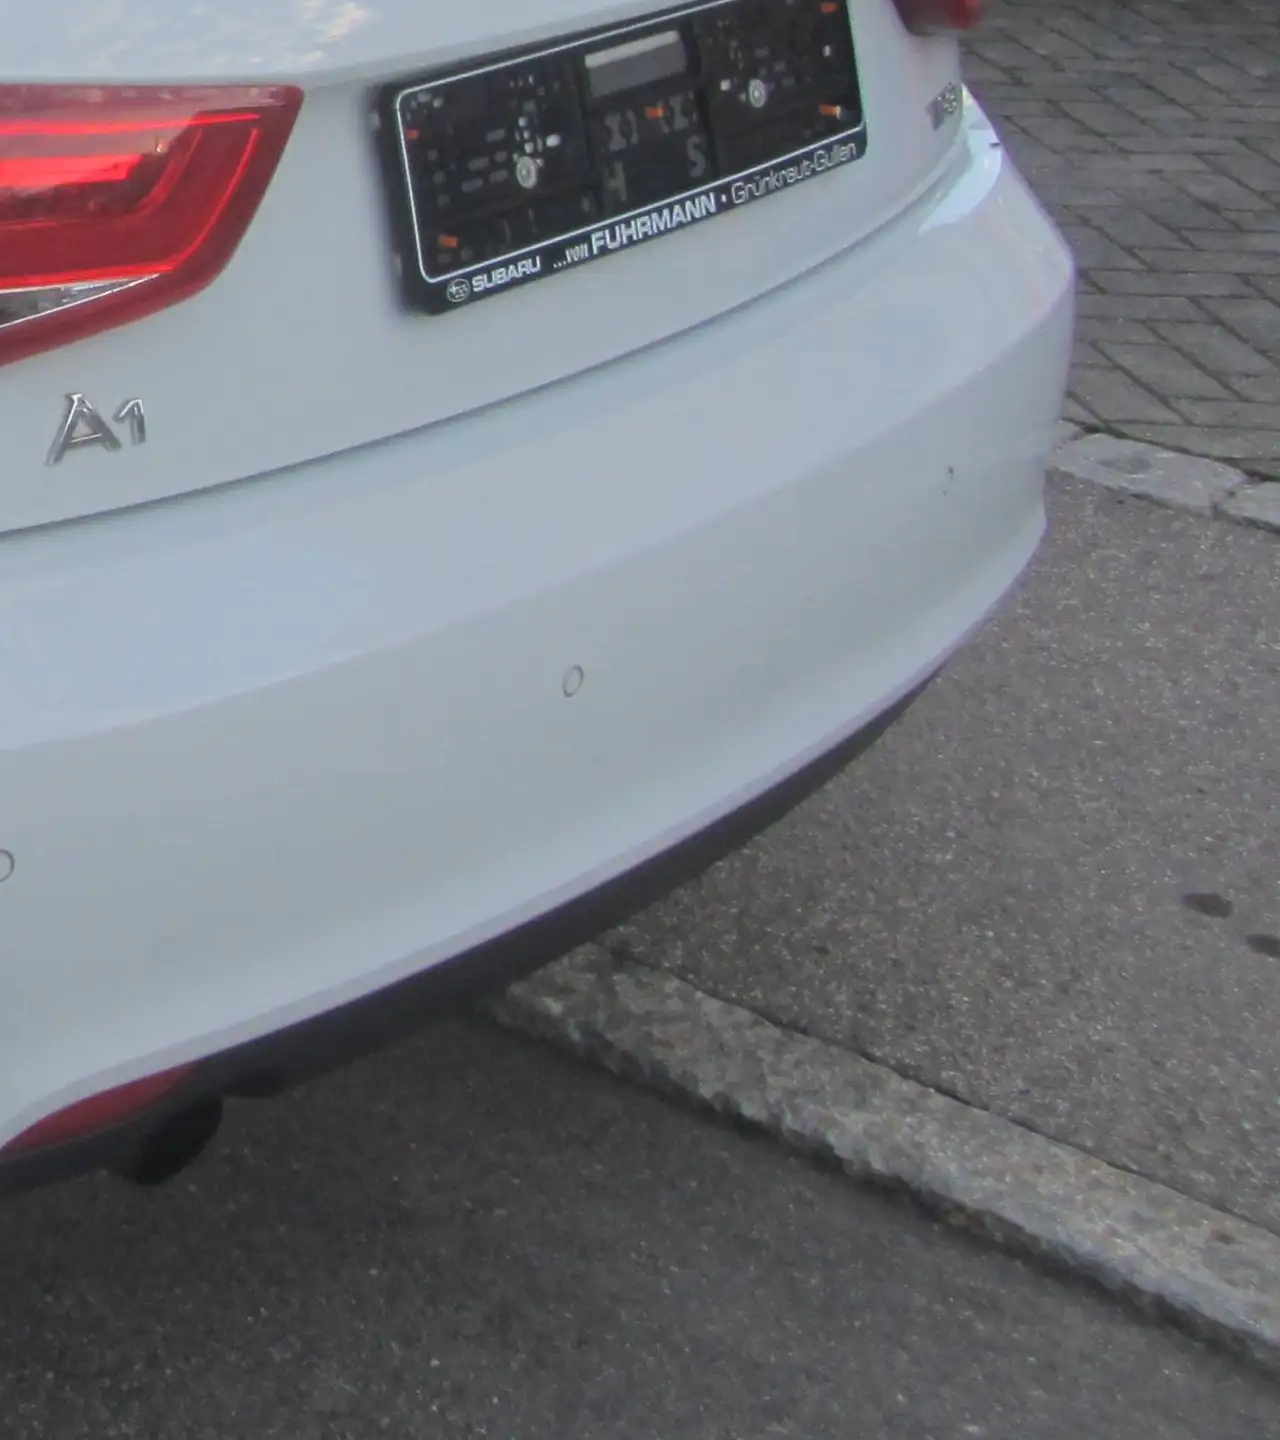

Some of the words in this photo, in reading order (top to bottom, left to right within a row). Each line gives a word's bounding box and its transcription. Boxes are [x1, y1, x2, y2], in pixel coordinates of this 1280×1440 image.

[471, 255, 541, 292] SUBARU
[591, 191, 717, 255] FUHRMANN
[730, 140, 857, 205] Grünkraut-Gullen
[44, 392, 146, 467] A1
